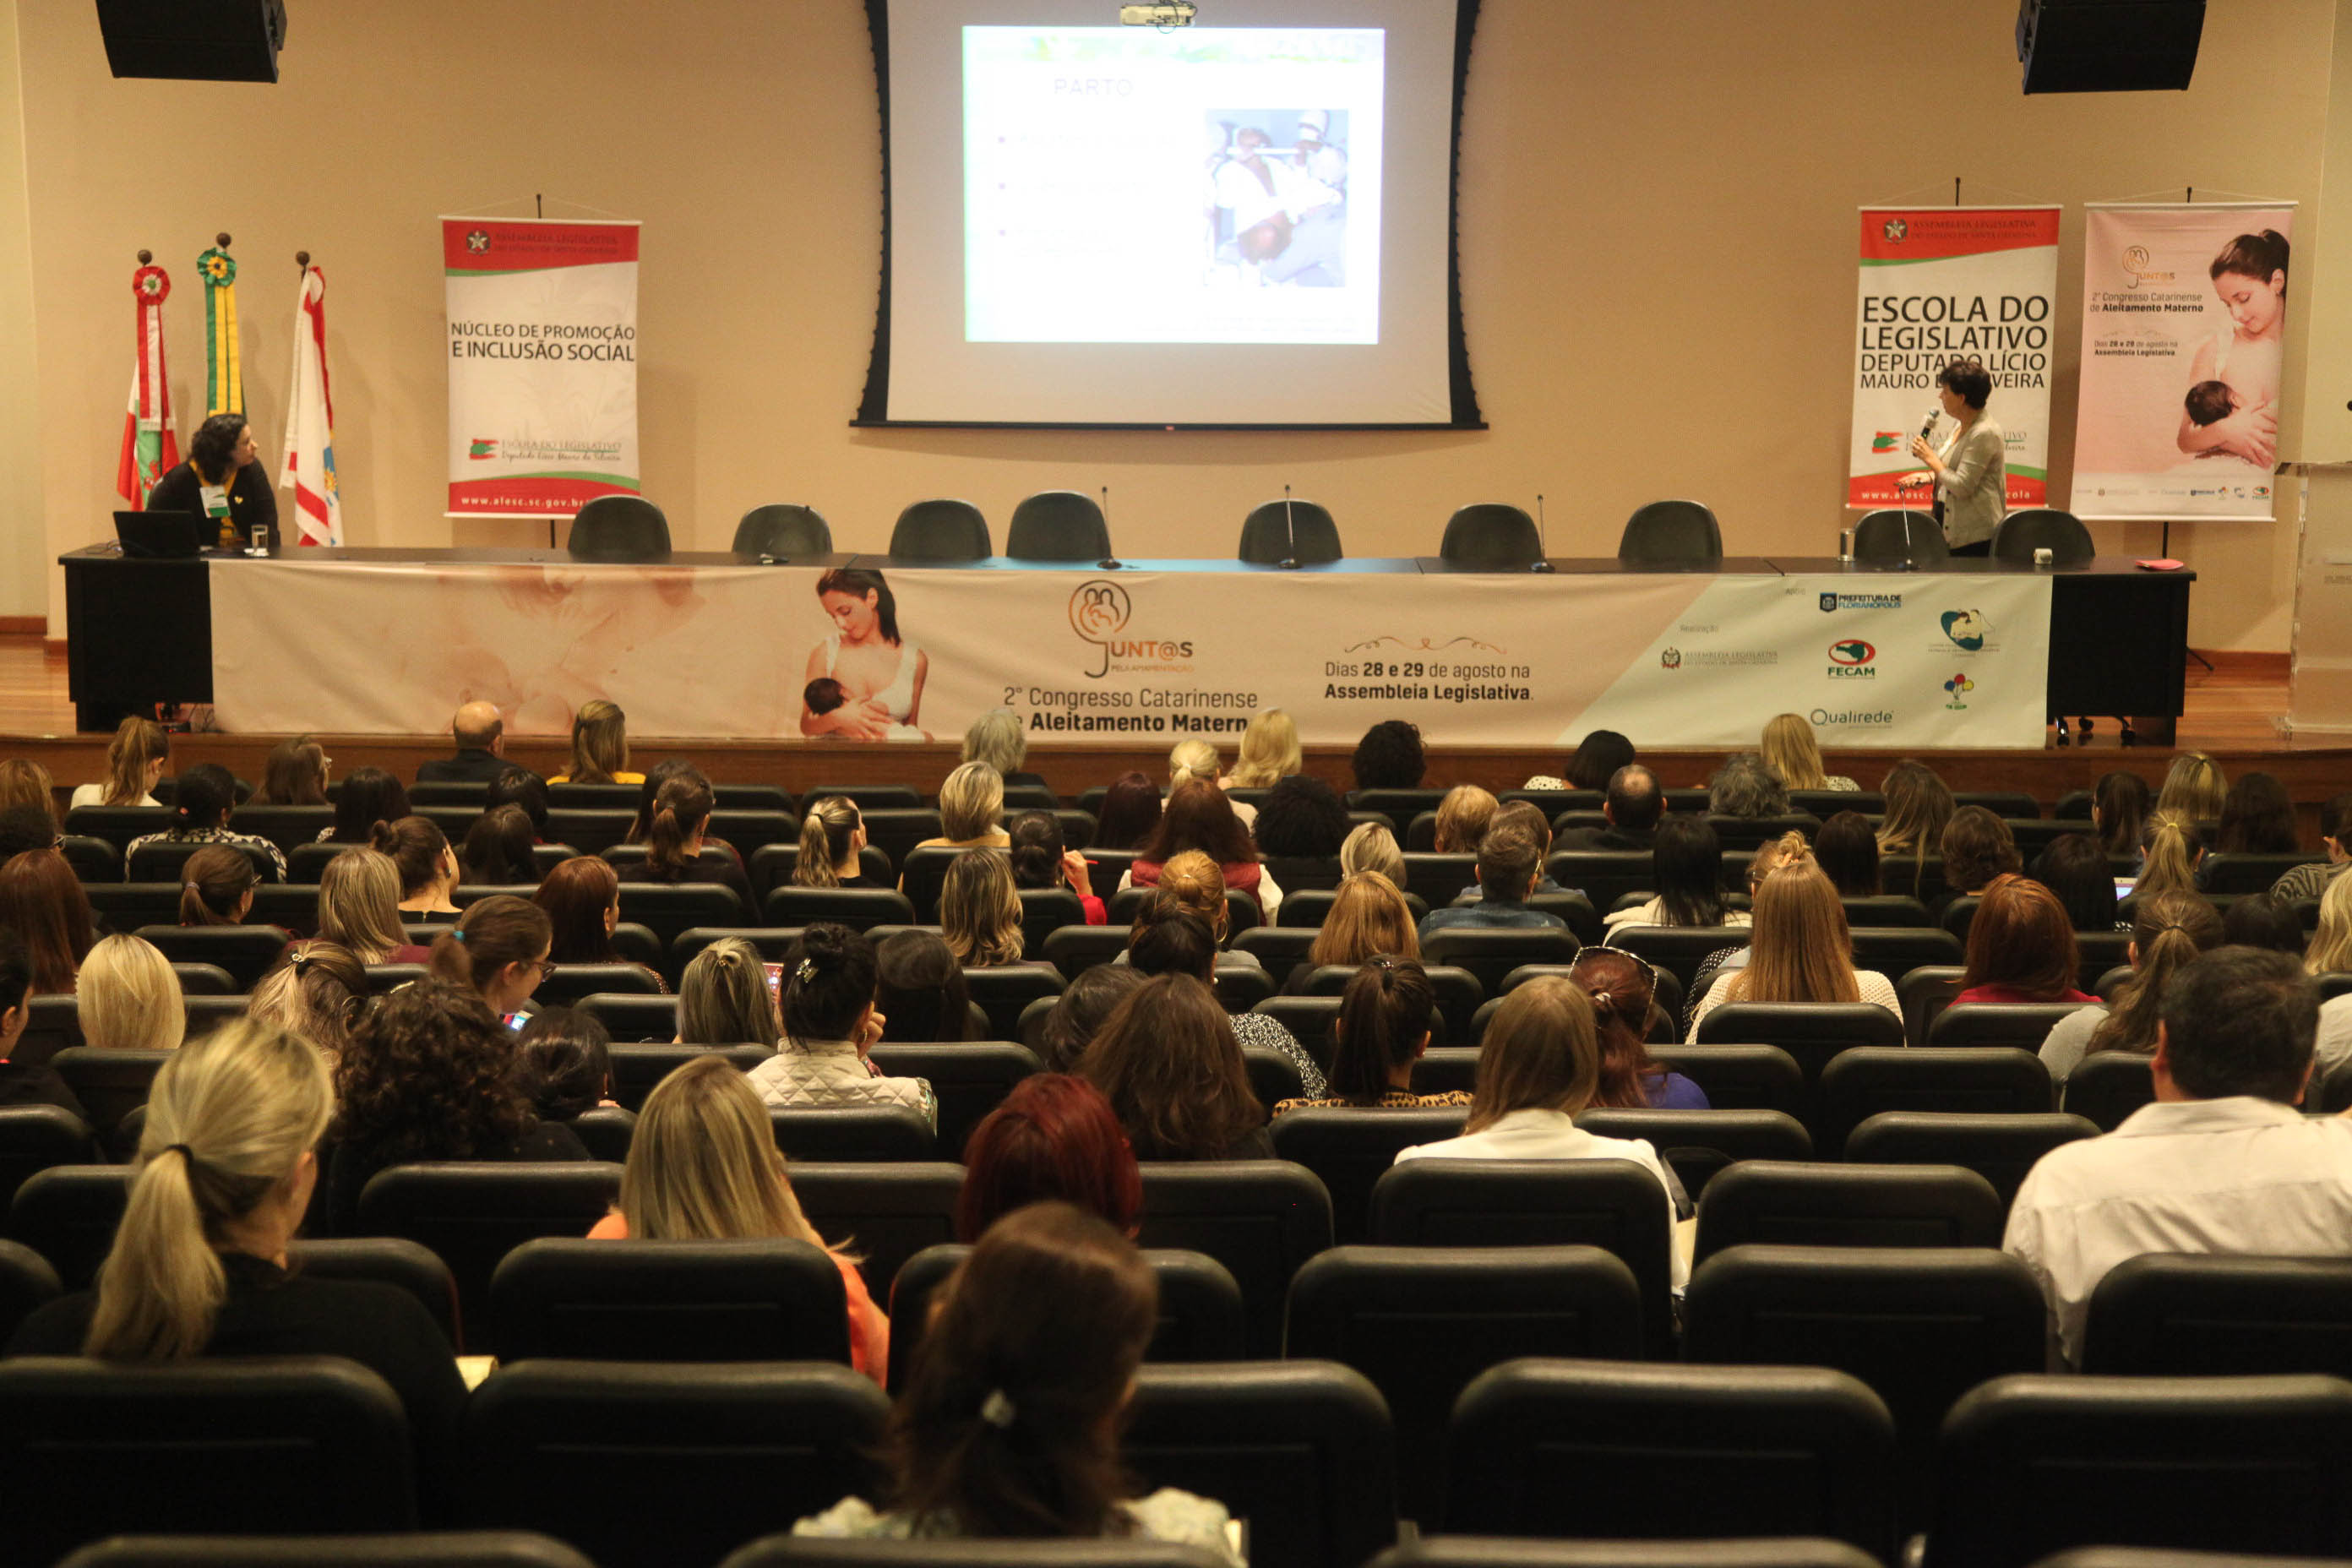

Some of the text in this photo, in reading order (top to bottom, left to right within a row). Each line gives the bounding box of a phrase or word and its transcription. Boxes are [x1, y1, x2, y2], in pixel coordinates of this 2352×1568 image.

[1054, 78, 1133, 97] PARTO
[2102, 291, 2148, 305] Congresso
[2150, 292, 2202, 302] Catarinense
[1864, 296, 2049, 323] ESCOLA DO
[2089, 303, 2203, 313] de Aleitamento Materno
[451, 320, 635, 343] NÚCLEO DE PROMOÇÃO
[1862, 325, 2048, 350] LEGISLATIVO
[453, 340, 635, 362] E INCLUSÃO SOCIAL
[1990, 350, 2046, 371] LÍCIO
[1860, 373, 1929, 389] MAURO
[461, 497, 585, 509] www.alesc.sc.gov.br
[1326, 662, 1530, 681] Dias 28 e 29 de agosto na
[1827, 667, 1876, 676] FECAM
[1029, 688, 1134, 710] Congresso
[1141, 689, 1258, 708] Catarinense
[1325, 683, 1428, 700] Assembleia
[1030, 711, 1165, 732] Aleitamento
[1172, 714, 1249, 732] Matern
